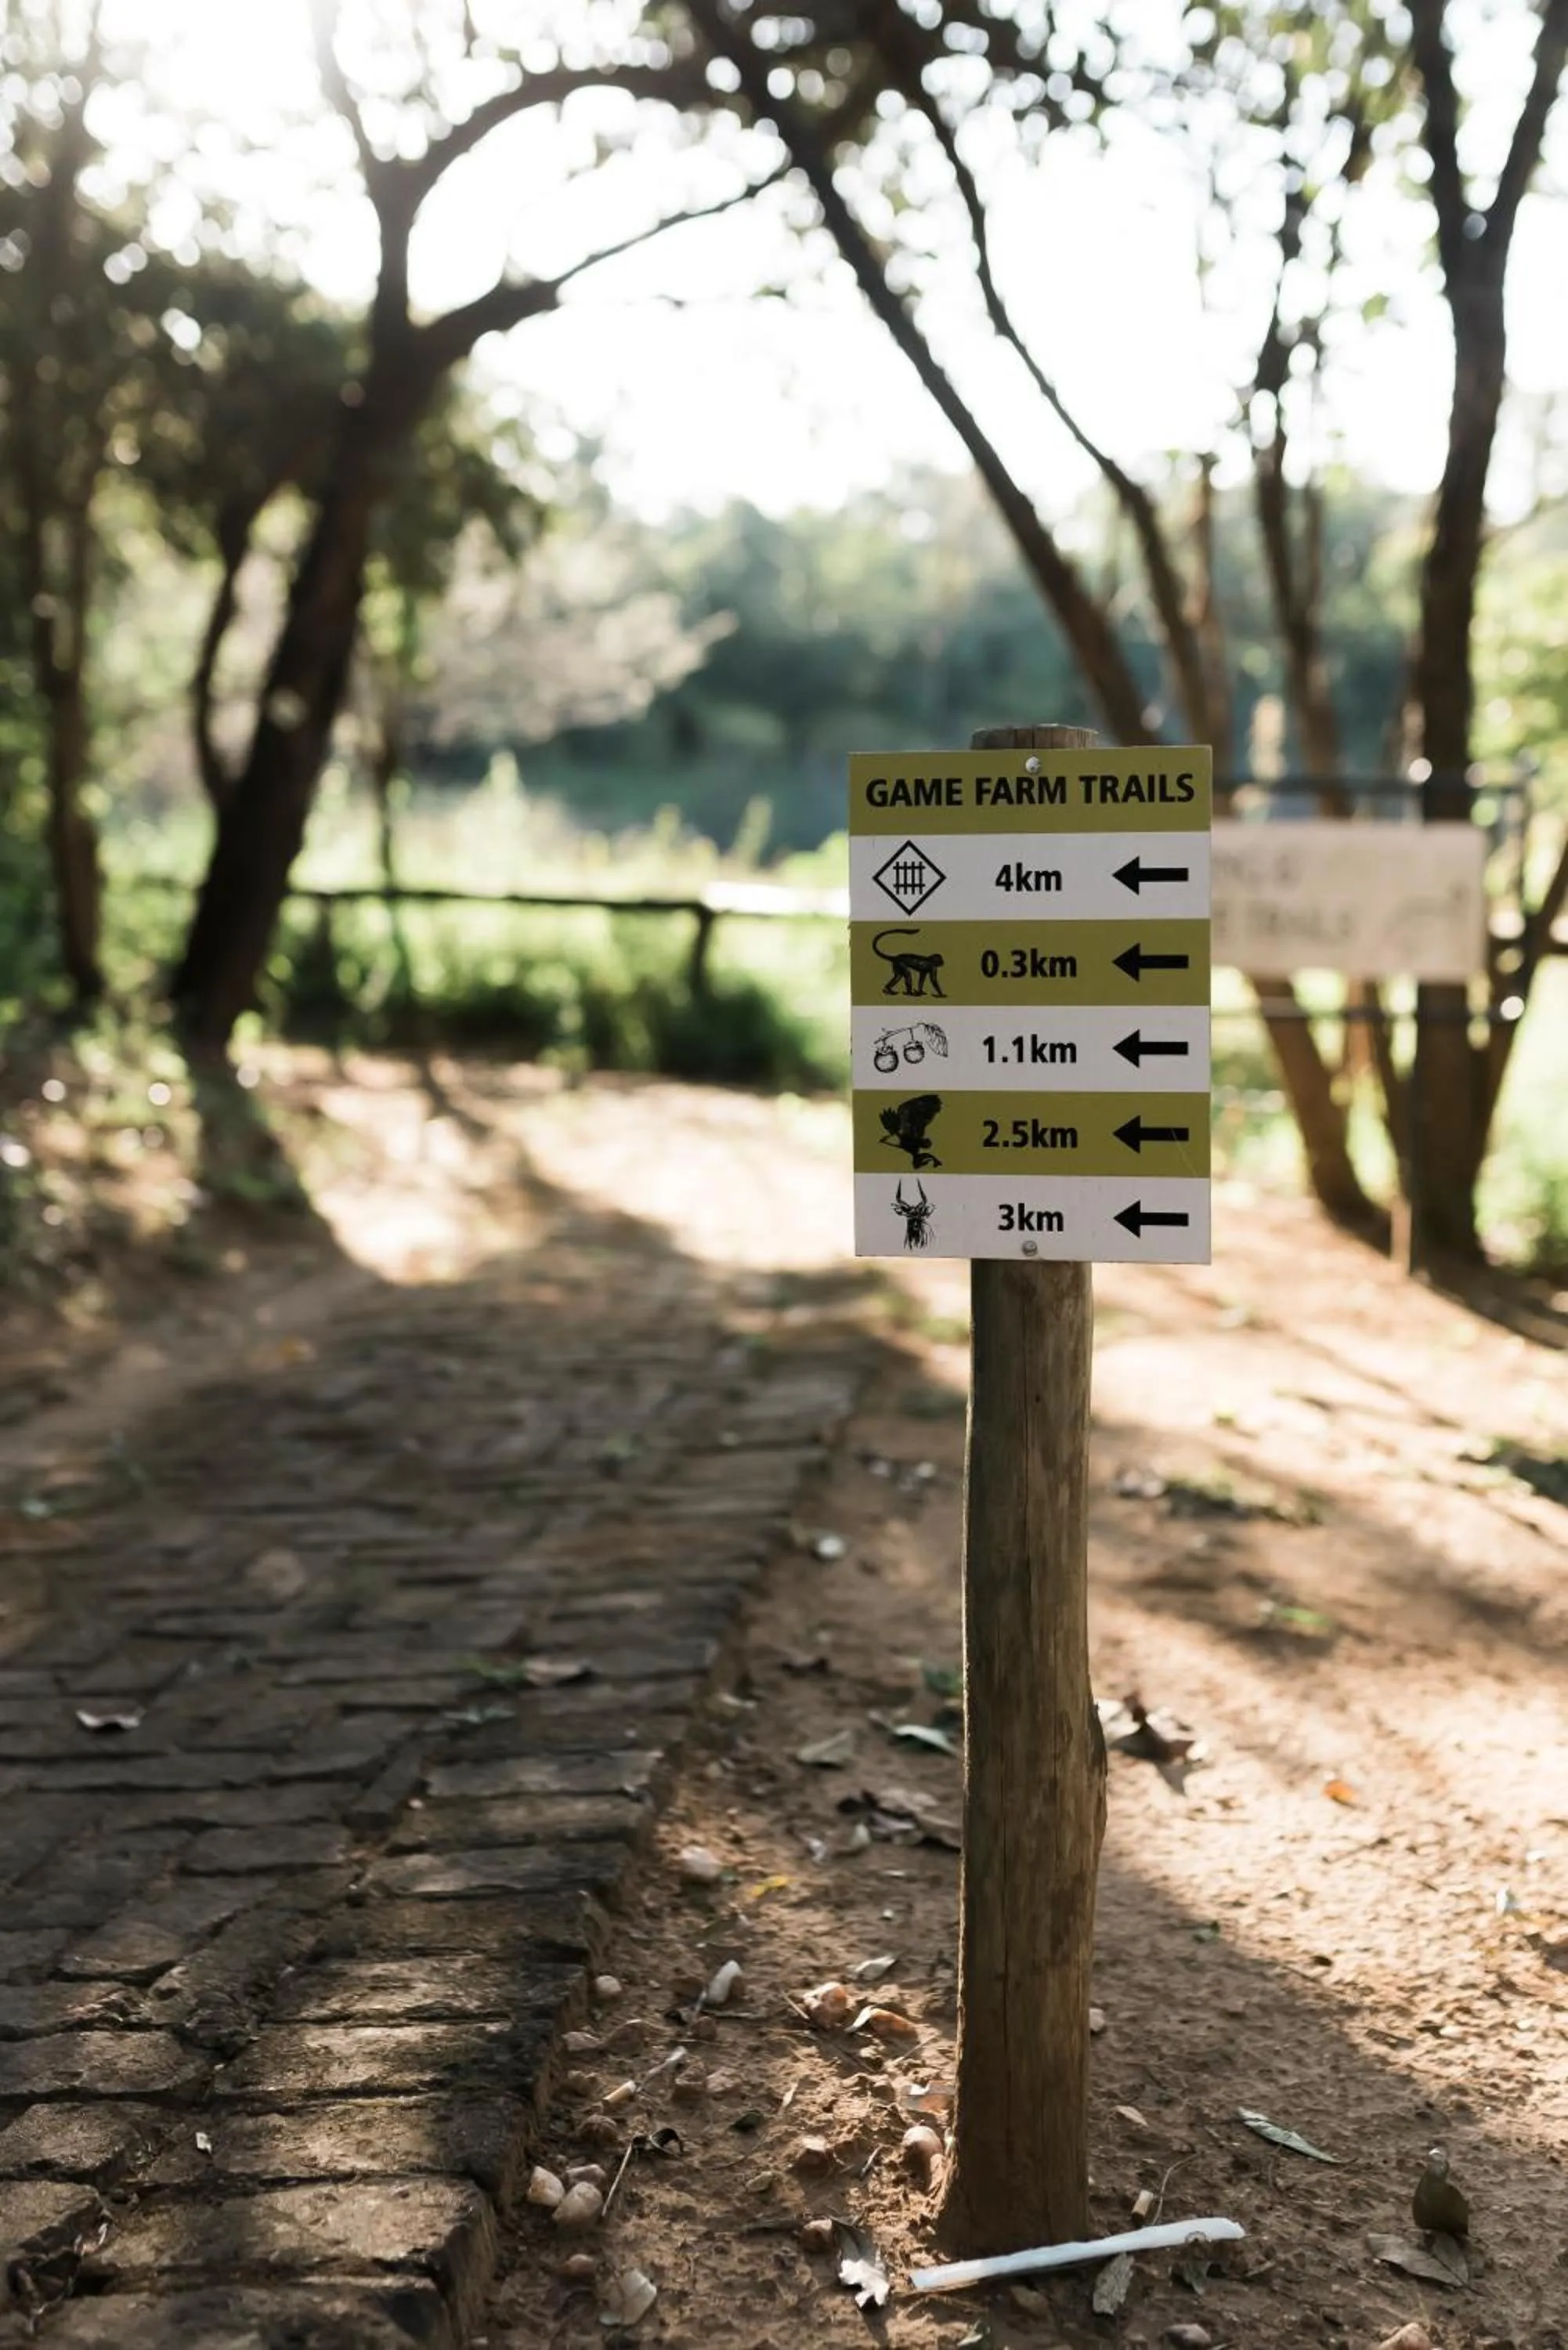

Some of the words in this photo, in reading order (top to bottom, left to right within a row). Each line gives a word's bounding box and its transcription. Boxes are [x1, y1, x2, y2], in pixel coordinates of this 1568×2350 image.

[865, 778, 963, 808] GAME
[975, 776, 1067, 806] FARM
[1078, 773, 1194, 804] TRAILS
[995, 862, 1062, 892] 4km
[981, 948, 1077, 978] 0.3km
[983, 1033, 1077, 1064] 1.1km
[983, 1118, 1078, 1148] 2.5km
[998, 1202, 1064, 1232] 3km
